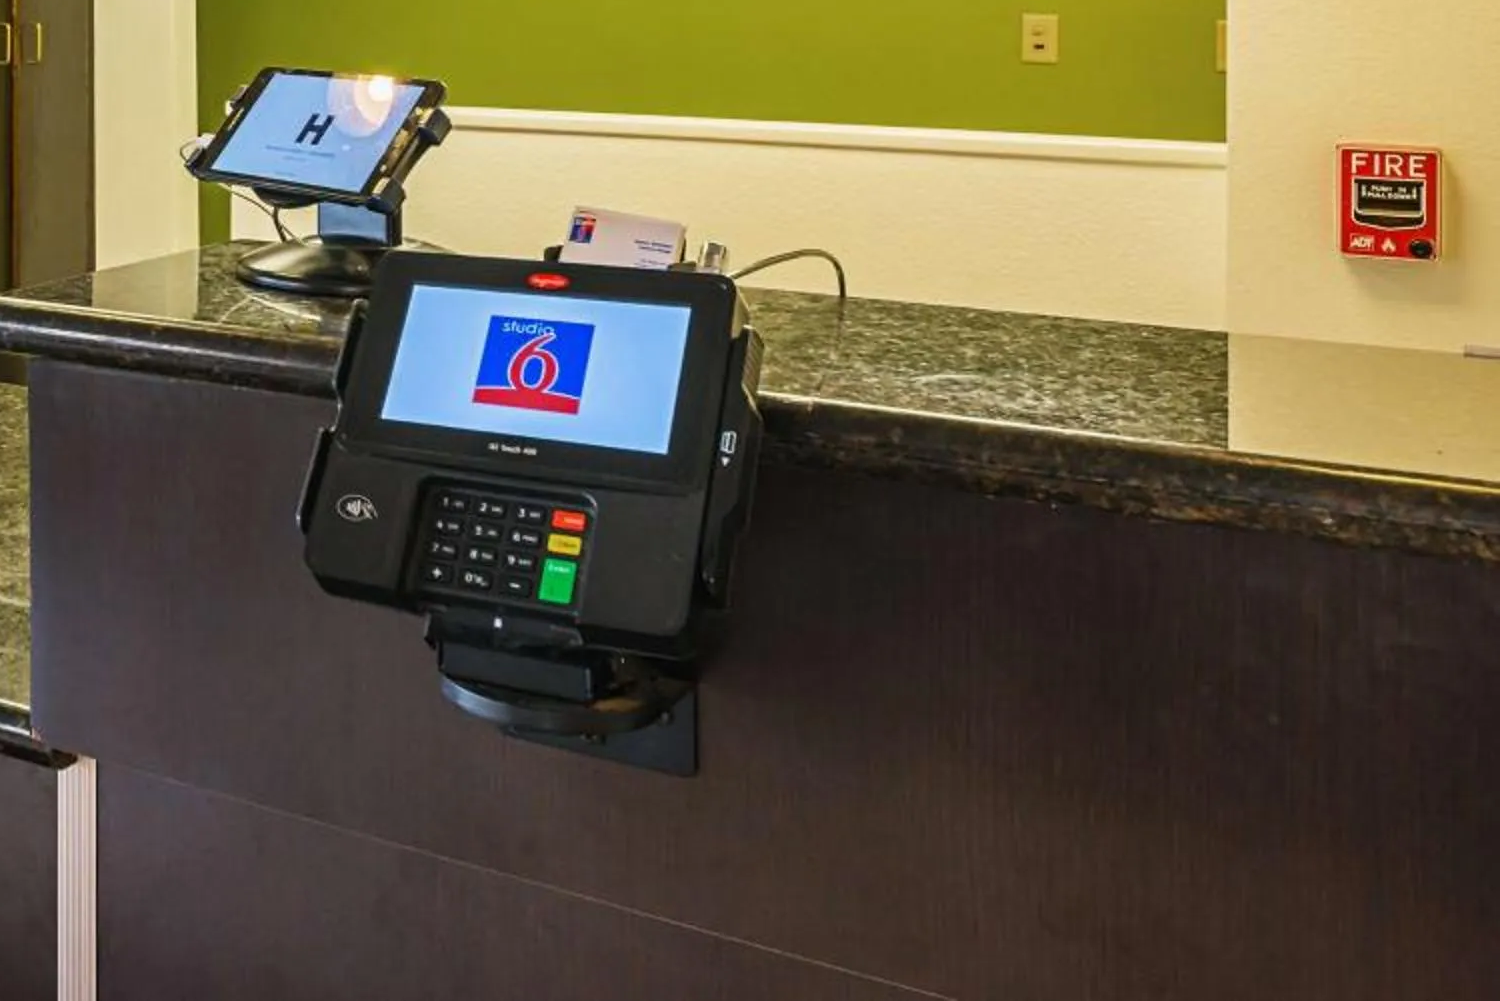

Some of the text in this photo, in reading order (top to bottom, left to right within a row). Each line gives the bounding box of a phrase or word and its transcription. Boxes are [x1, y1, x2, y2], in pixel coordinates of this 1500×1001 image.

[294, 113, 335, 145] H
[1351, 152, 1427, 178] FIRE
[501, 319, 556, 336] studio
[507, 332, 560, 392] 6
